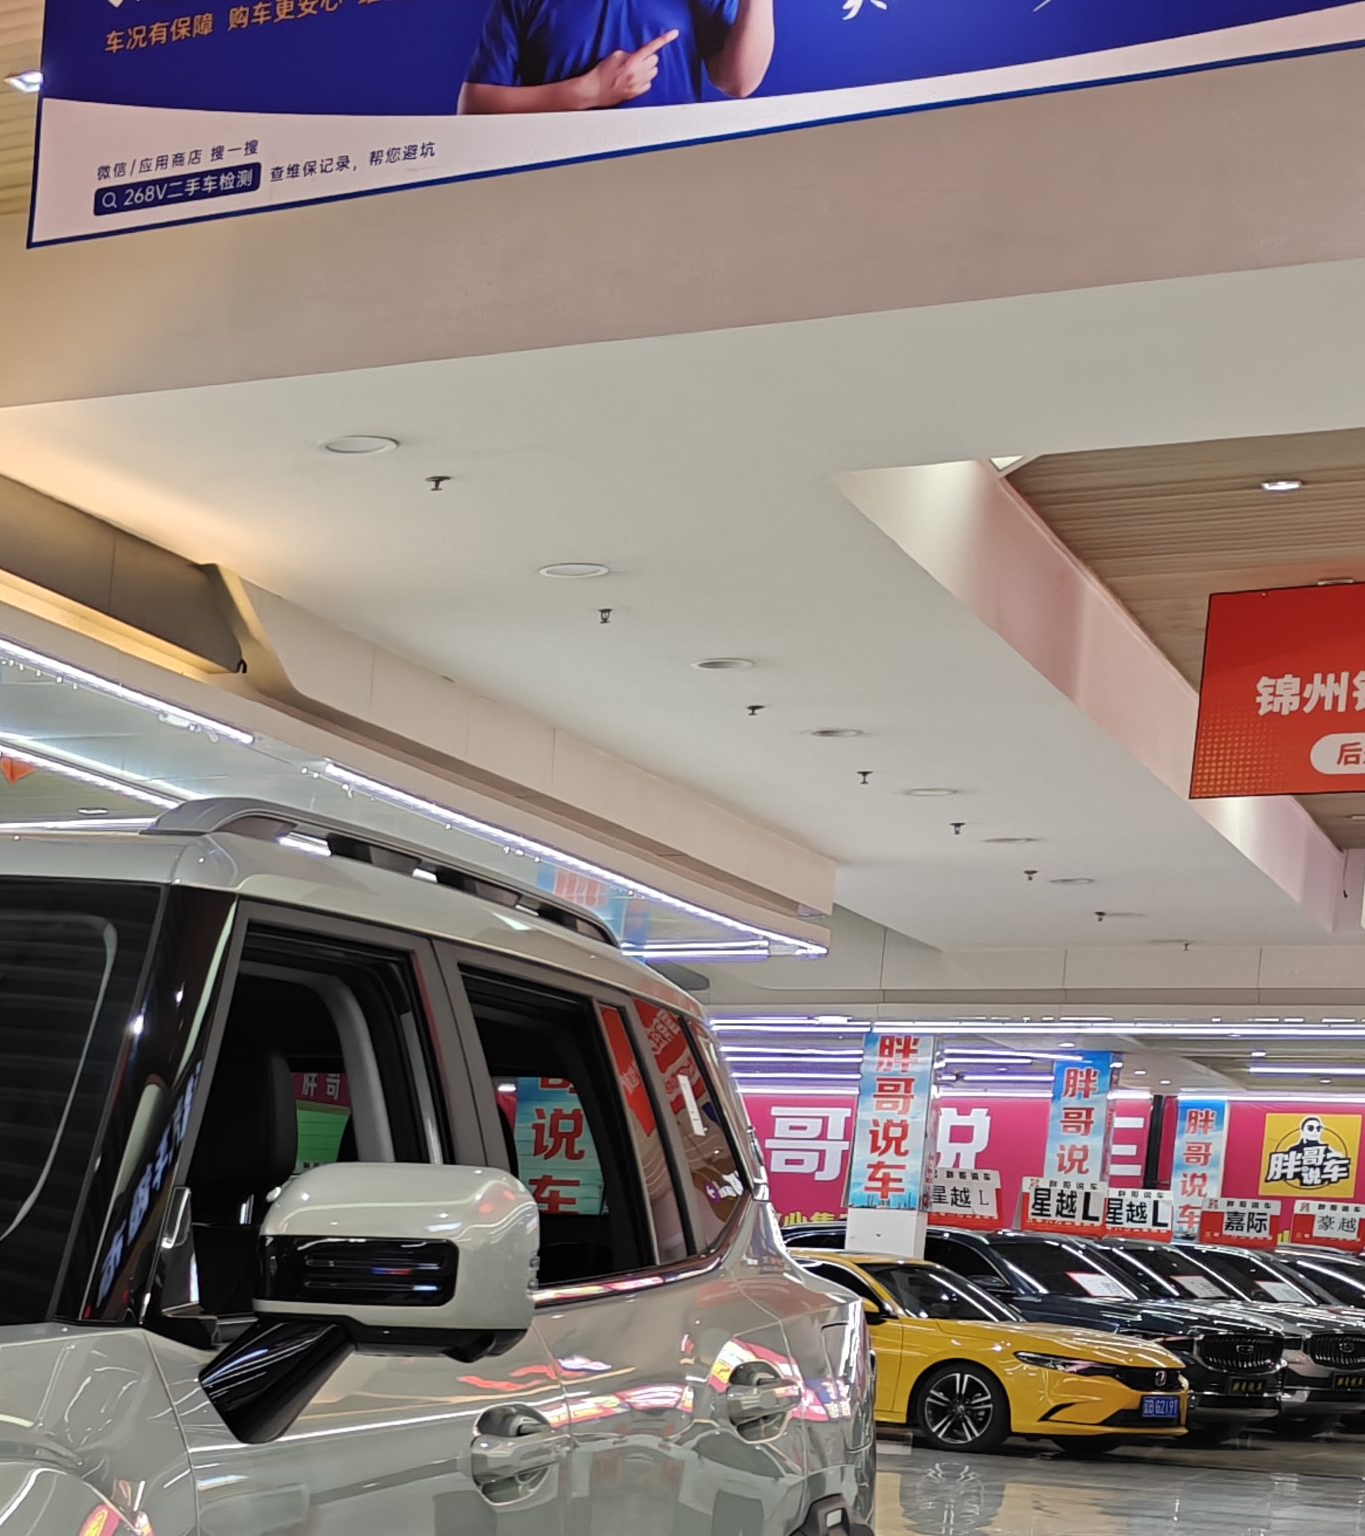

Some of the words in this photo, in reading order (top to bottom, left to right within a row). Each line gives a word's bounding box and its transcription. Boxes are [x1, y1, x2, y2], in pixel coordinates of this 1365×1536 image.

[103, 12, 214, 54] 车况有保障
[209, 138, 259, 163] 搜一搜
[122, 167, 255, 207] 268V二手车检测
[1255, 671, 1365, 717] 锦州
[863, 1034, 921, 1200] 胖哥说车
[1056, 1067, 1100, 1176] 胖哥说
[1176, 1108, 1217, 1229] 胖哥说车
[1030, 1187, 1100, 1222] 星越L
[1106, 1197, 1169, 1228] 星越L
[1224, 1211, 1268, 1234] 嘉际
[1317, 1214, 1358, 1234] 豪越
